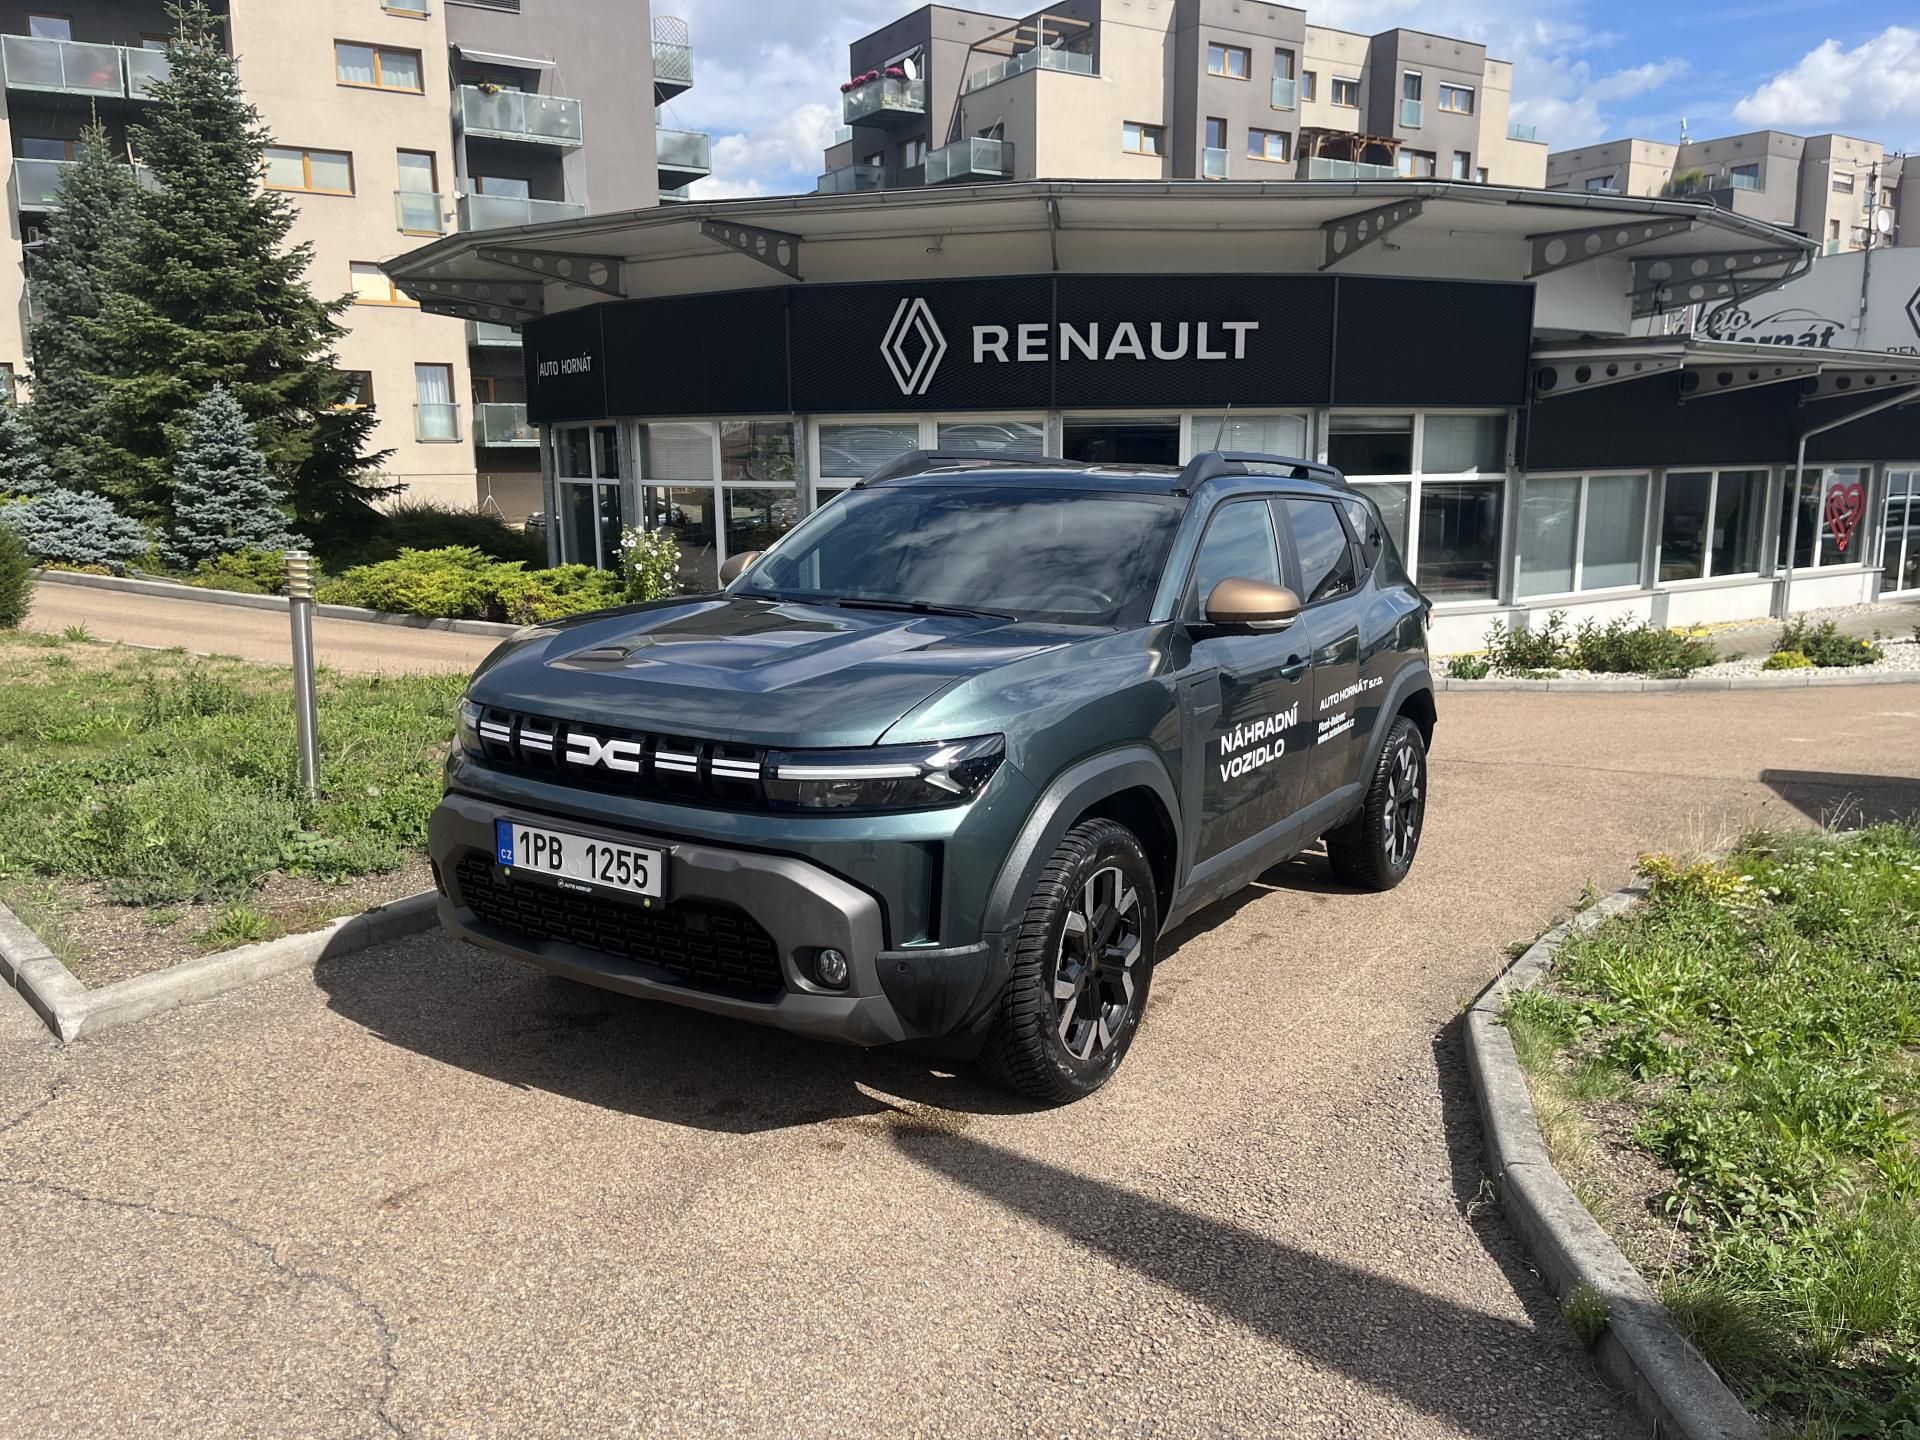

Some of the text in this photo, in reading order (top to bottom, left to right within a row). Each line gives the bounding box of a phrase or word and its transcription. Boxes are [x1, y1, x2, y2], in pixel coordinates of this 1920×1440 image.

[972, 321, 1259, 363] RENAULT
[539, 351, 592, 377] AUTO HORNÁT
[1319, 676, 1384, 712] AUTO HORNÁT s.r.o.
[1220, 701, 1299, 756] NÁHRADNÍ
[1220, 739, 1285, 783] VOZIDLO
[501, 849, 513, 860] CZ
[520, 831, 649, 889] 1PB 1255
